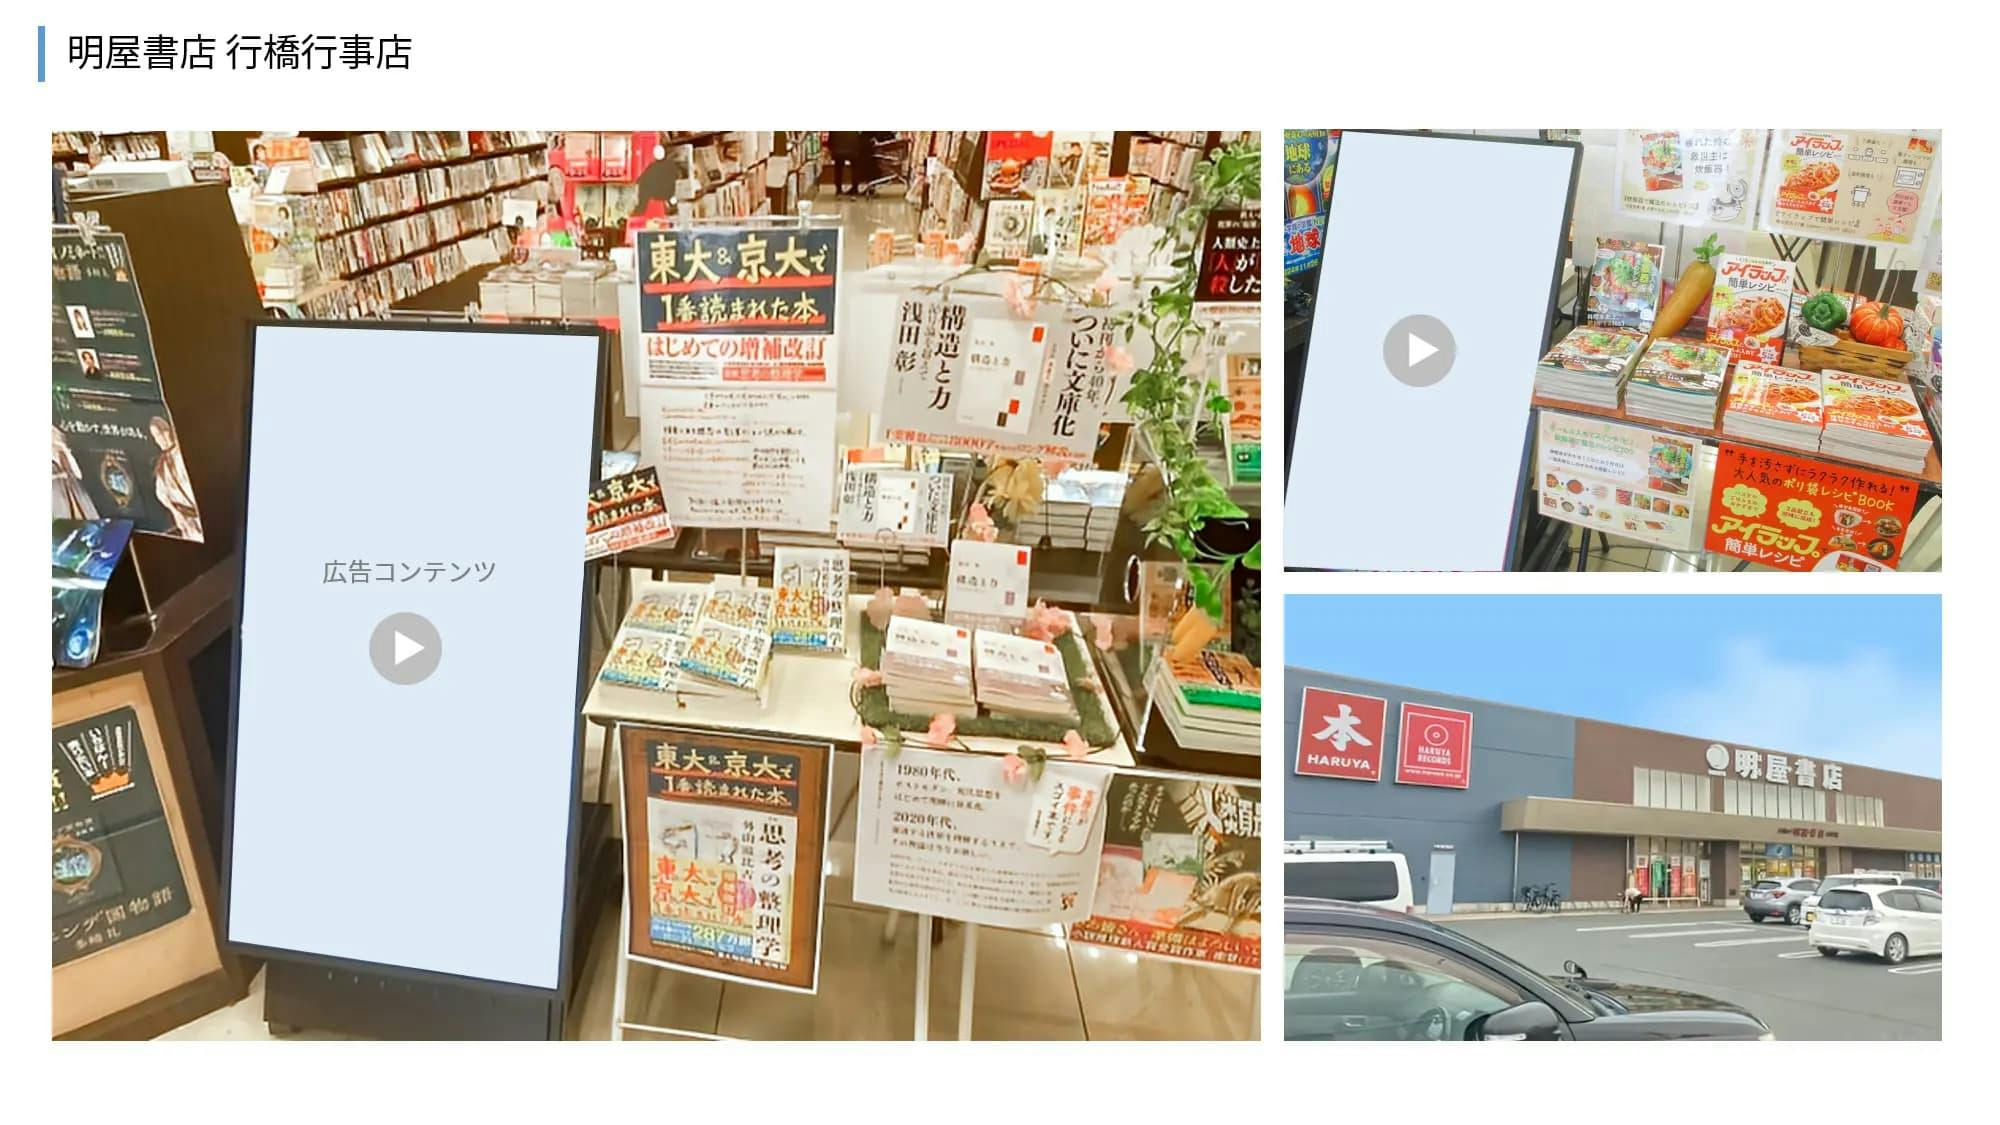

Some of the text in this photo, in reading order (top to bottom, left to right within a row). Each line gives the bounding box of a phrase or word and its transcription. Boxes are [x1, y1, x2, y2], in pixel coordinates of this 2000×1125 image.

[1285, 143, 1311, 161] 地球
[1290, 228, 1321, 254] 地球
[1728, 277, 1777, 293] 簡単レシピ
[661, 291, 819, 325] 1番読まれた本
[647, 336, 826, 361] はじめての増補改訂
[928, 304, 967, 411] 構造と力
[1052, 315, 1098, 437] ついに文庫化
[1725, 537, 1806, 568] 簡単レシピ
[1312, 704, 1373, 751] 本
[1307, 754, 1370, 770] HARUYA
[1417, 755, 1451, 766] RECORDS
[1418, 745, 1451, 757] HARUYA
[1735, 749, 1843, 791] 明屋書店
[756, 822, 787, 957] 思考の整理学
